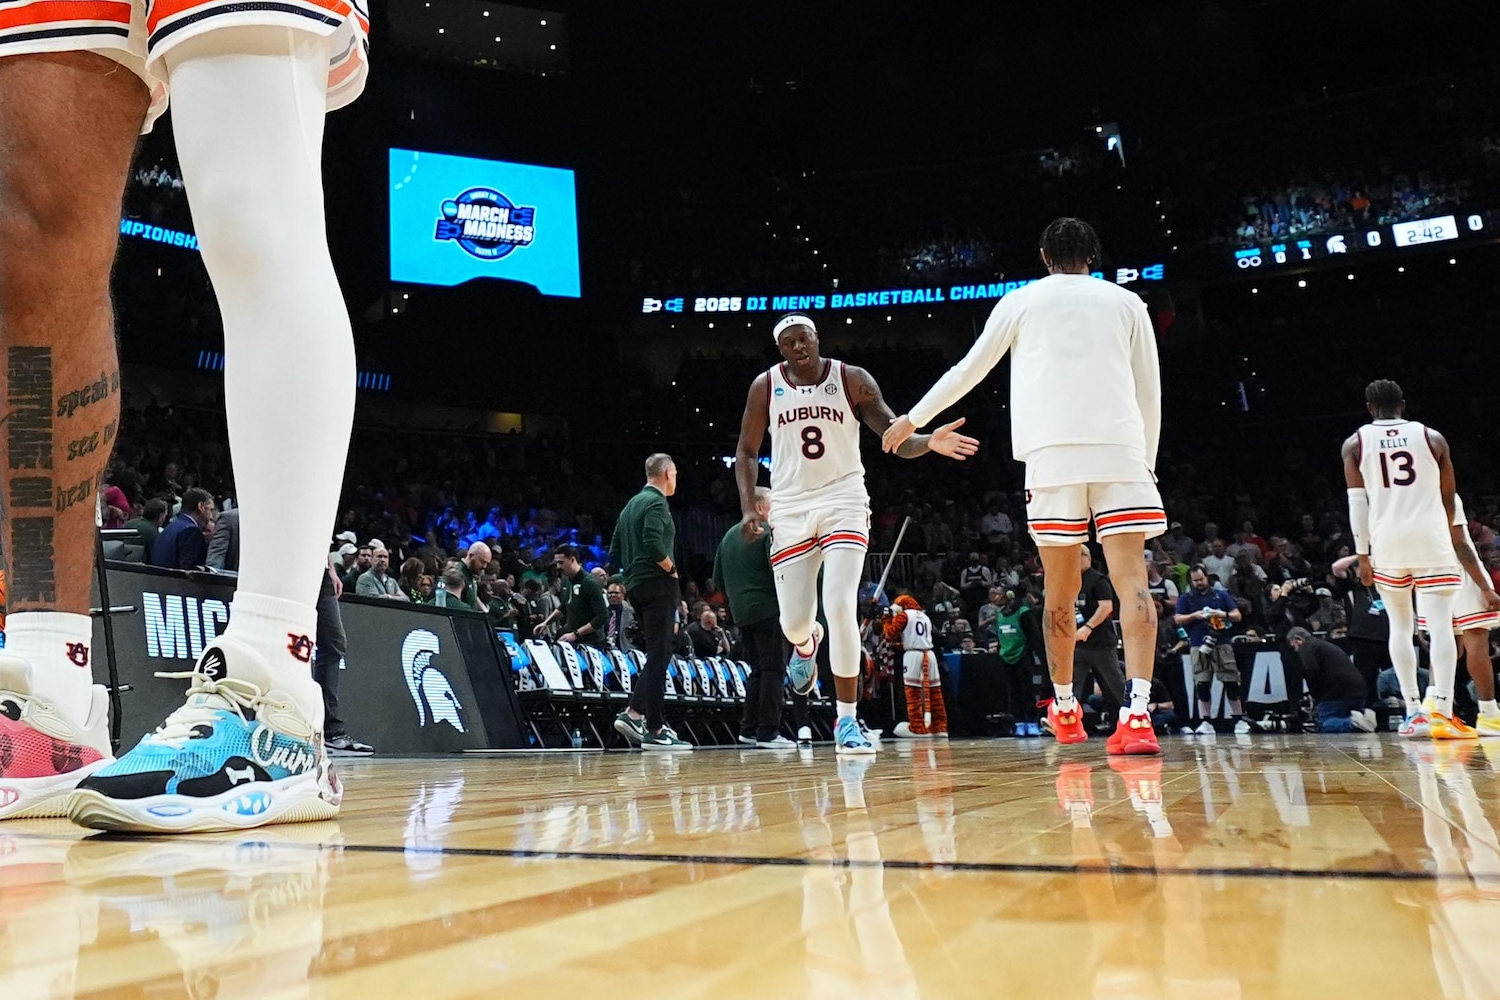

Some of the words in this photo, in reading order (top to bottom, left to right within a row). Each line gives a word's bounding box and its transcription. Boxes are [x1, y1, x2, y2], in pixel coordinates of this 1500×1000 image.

[457, 203, 510, 224] MARCH
[464, 220, 534, 242] MADNESS
[1406, 226, 1444, 243] 2:42
[694, 296, 742, 312] 2025
[746, 296, 767, 311] DI
[771, 295, 826, 311] MEN'S
[830, 287, 945, 309] BASKETBALL
[778, 406, 844, 428] AUBURN
[801, 426, 825, 460] 8
[1380, 437, 1408, 449] KELLY
[1379, 451, 1416, 488] 13
